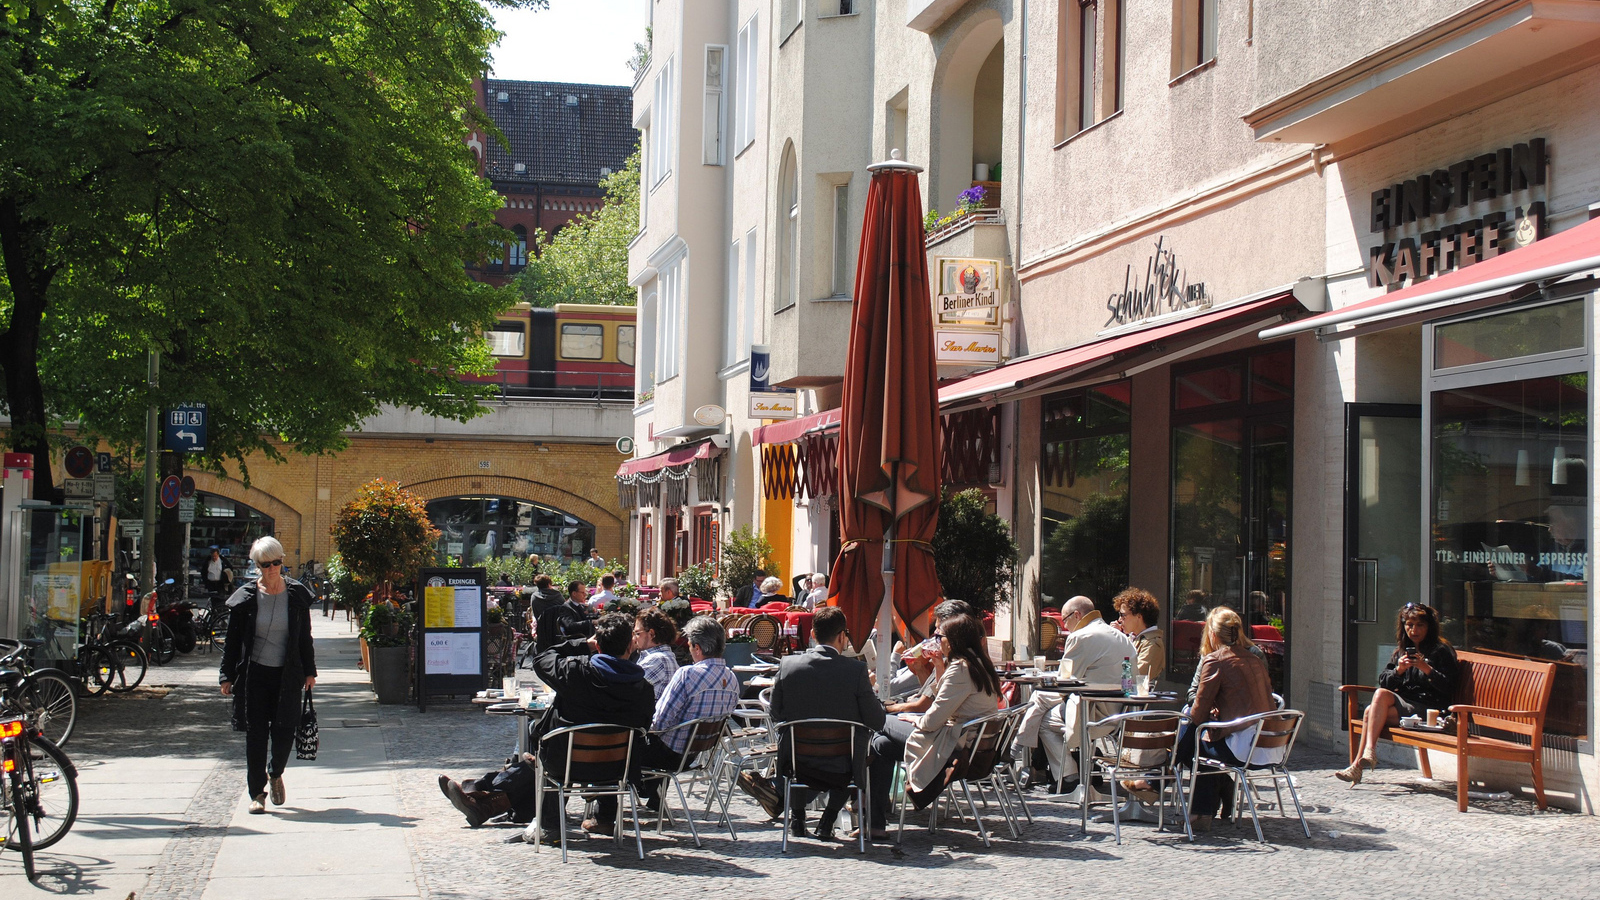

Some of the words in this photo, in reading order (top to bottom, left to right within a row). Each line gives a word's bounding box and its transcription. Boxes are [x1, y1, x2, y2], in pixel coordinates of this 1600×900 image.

[1370, 138, 1545, 233] EINSTEIN
[1370, 211, 1506, 288] KAFFEE
[943, 295, 974, 310] Berliner
[975, 291, 995, 307] Kindl
[940, 340, 963, 352] San
[963, 341, 996, 353] Marino
[1463, 549, 1526, 565] EINSPÄNNER
